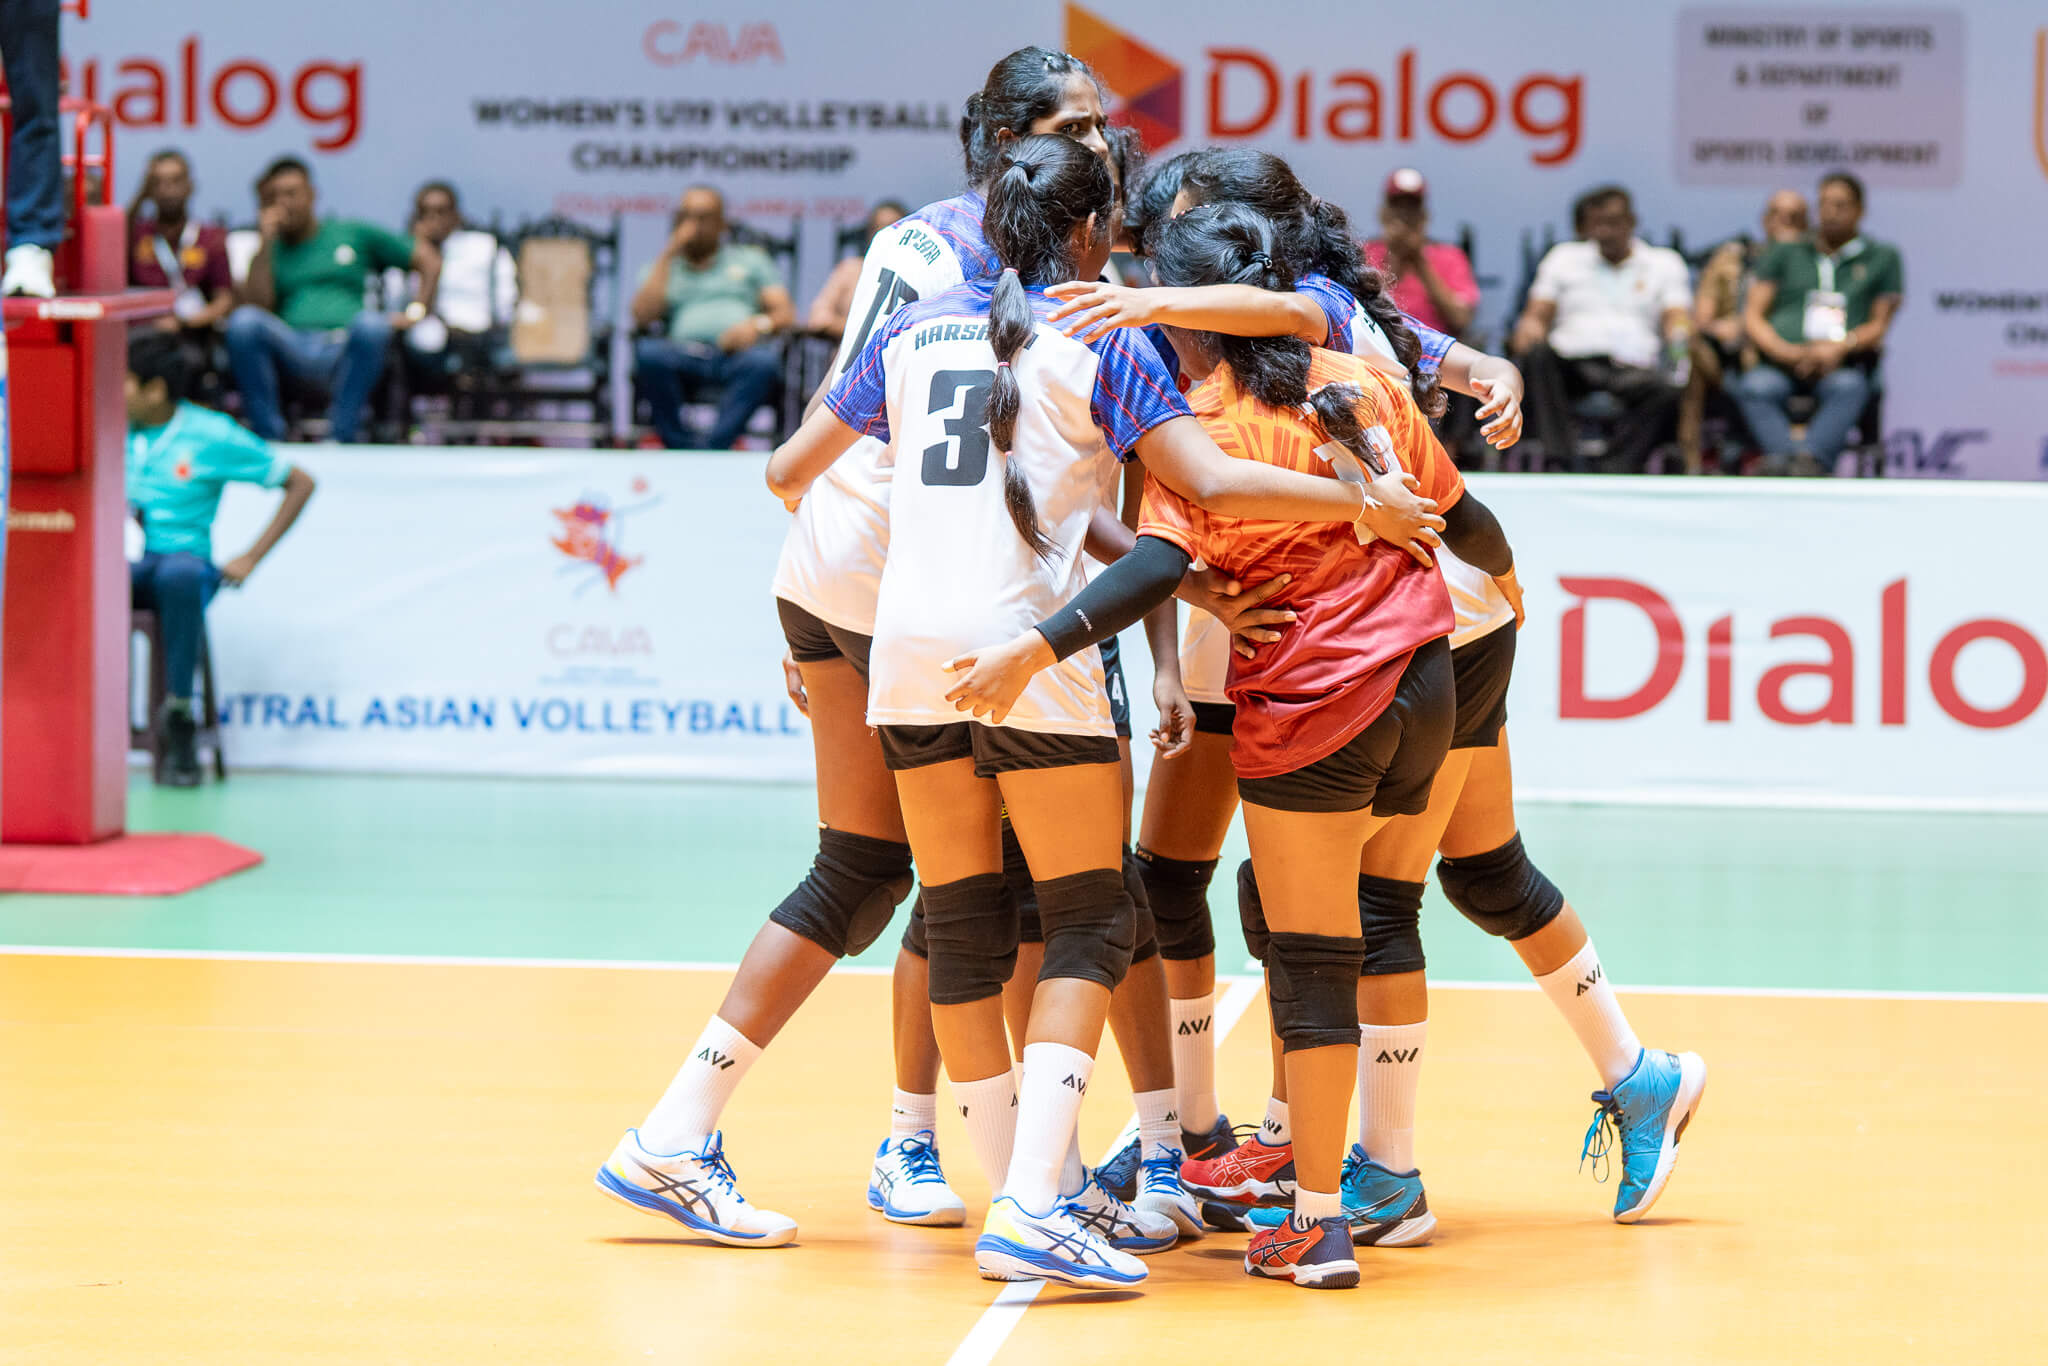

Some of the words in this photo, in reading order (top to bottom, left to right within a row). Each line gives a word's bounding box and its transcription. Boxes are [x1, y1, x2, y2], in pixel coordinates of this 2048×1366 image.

[644, 20, 784, 65] CAVA
[59, 36, 364, 151] ialog
[475, 99, 645, 129] WOMEN'S
[724, 101, 953, 132] VOLLEYBALL
[1205, 47, 1588, 167] Dialog
[570, 141, 857, 174] CHAMPIONSHIP
[920, 369, 998, 486] 3
[1556, 576, 2048, 730] Dialo
[215, 694, 348, 730] NTRAL
[361, 695, 496, 729] ASIAN
[510, 698, 800, 734] VOLLEYBALL
